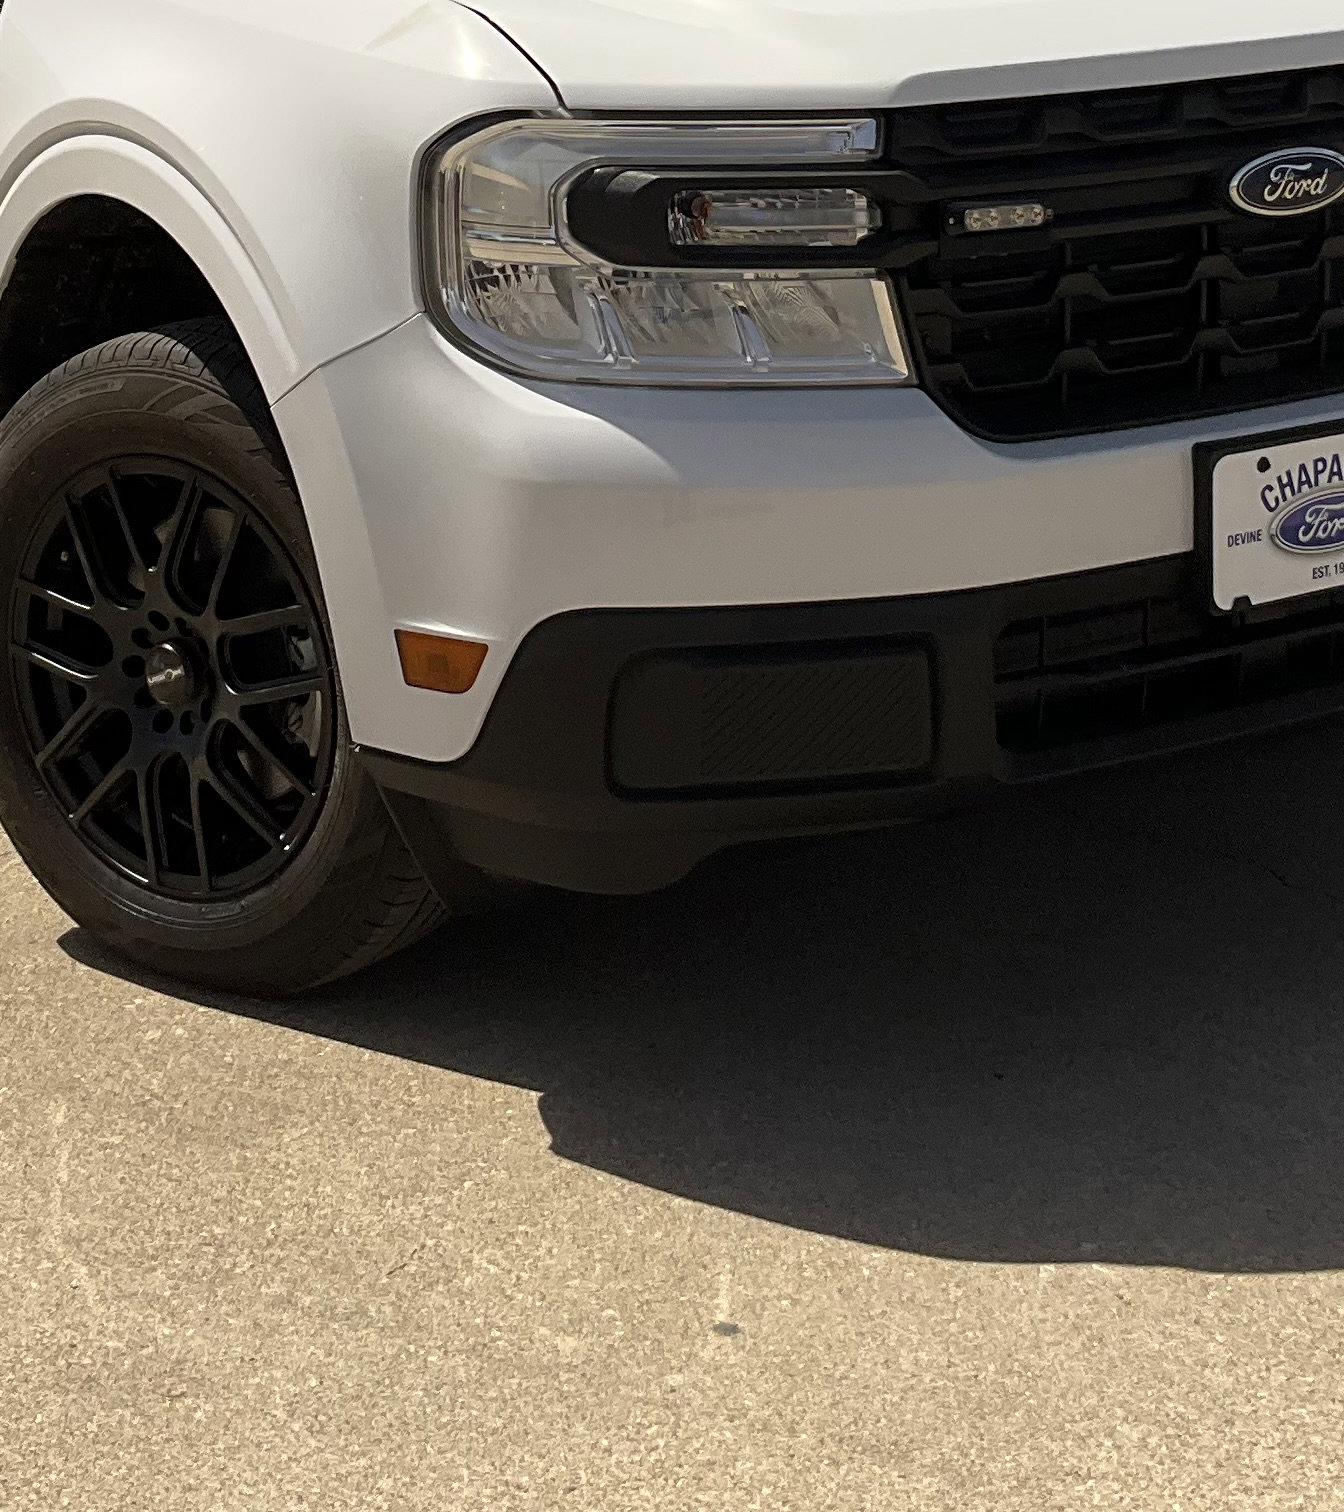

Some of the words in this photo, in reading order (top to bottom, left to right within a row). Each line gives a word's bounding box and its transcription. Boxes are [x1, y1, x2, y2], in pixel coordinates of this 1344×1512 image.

[1263, 162, 1329, 202] Ford
[1227, 528, 1263, 548] DEVINE
[1312, 564, 1332, 580] EST.
